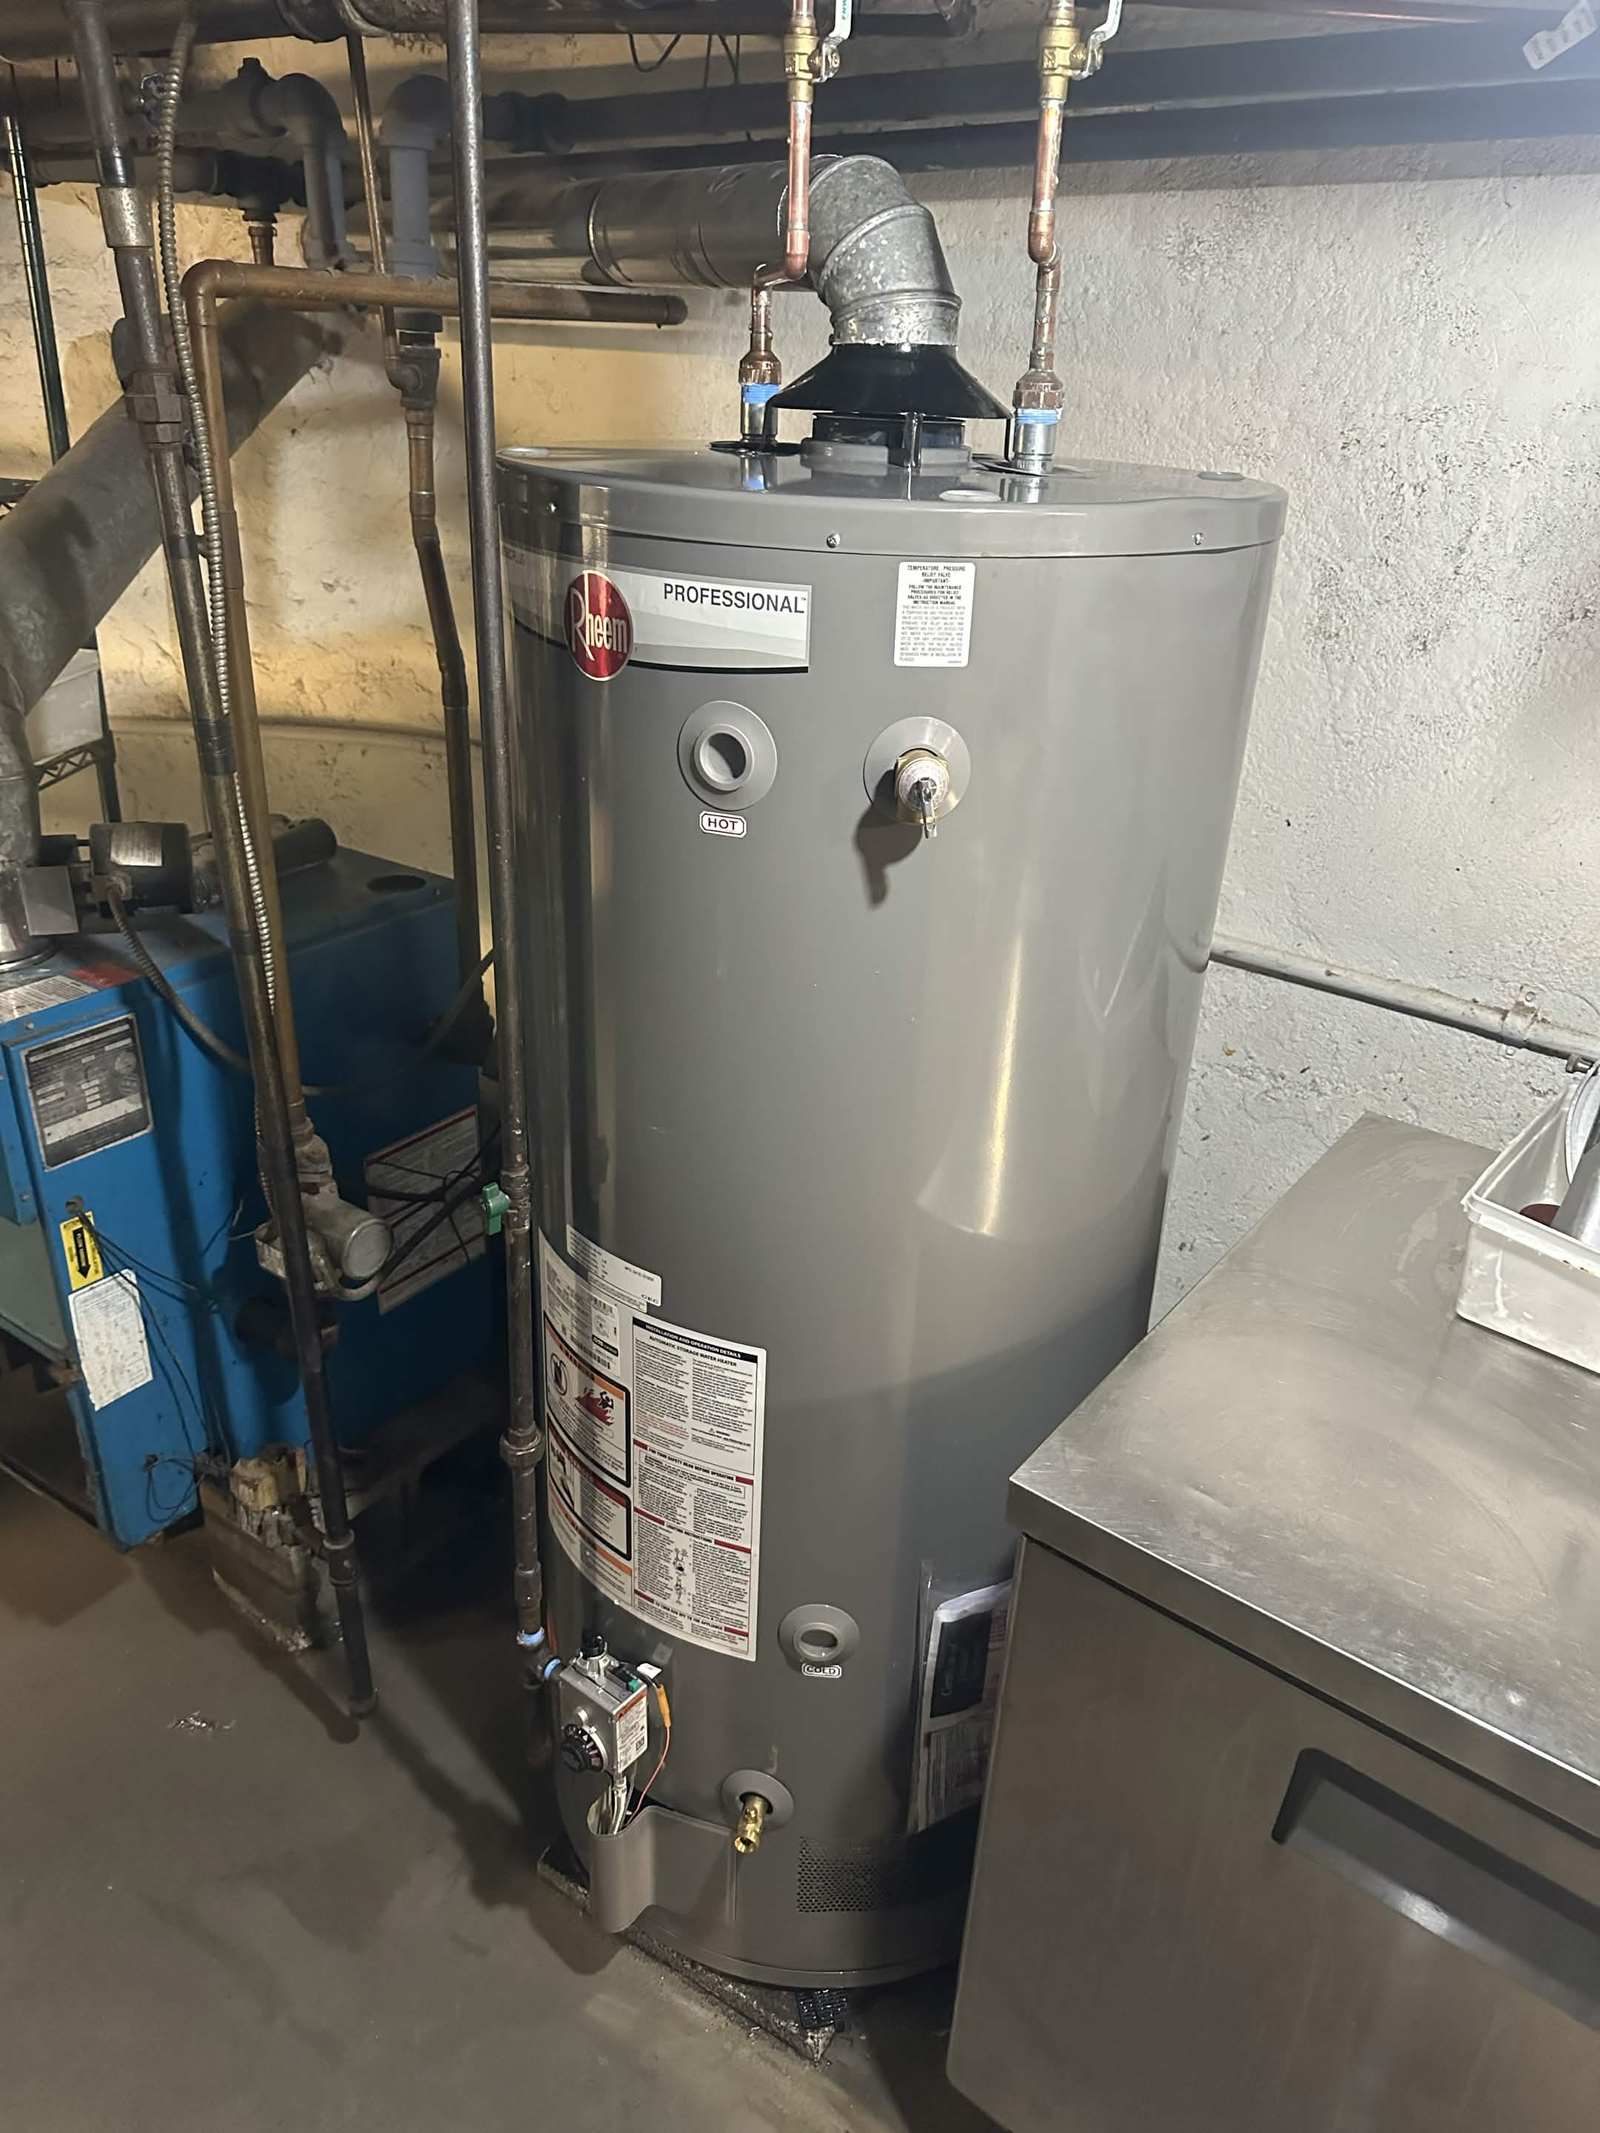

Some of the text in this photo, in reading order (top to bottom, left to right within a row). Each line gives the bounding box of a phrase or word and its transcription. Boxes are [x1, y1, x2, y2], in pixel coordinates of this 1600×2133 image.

[570, 571, 805, 661] Rheem PROFESSIONAL
[708, 817, 738, 831] HOT
[806, 1665, 836, 1675] COLD
